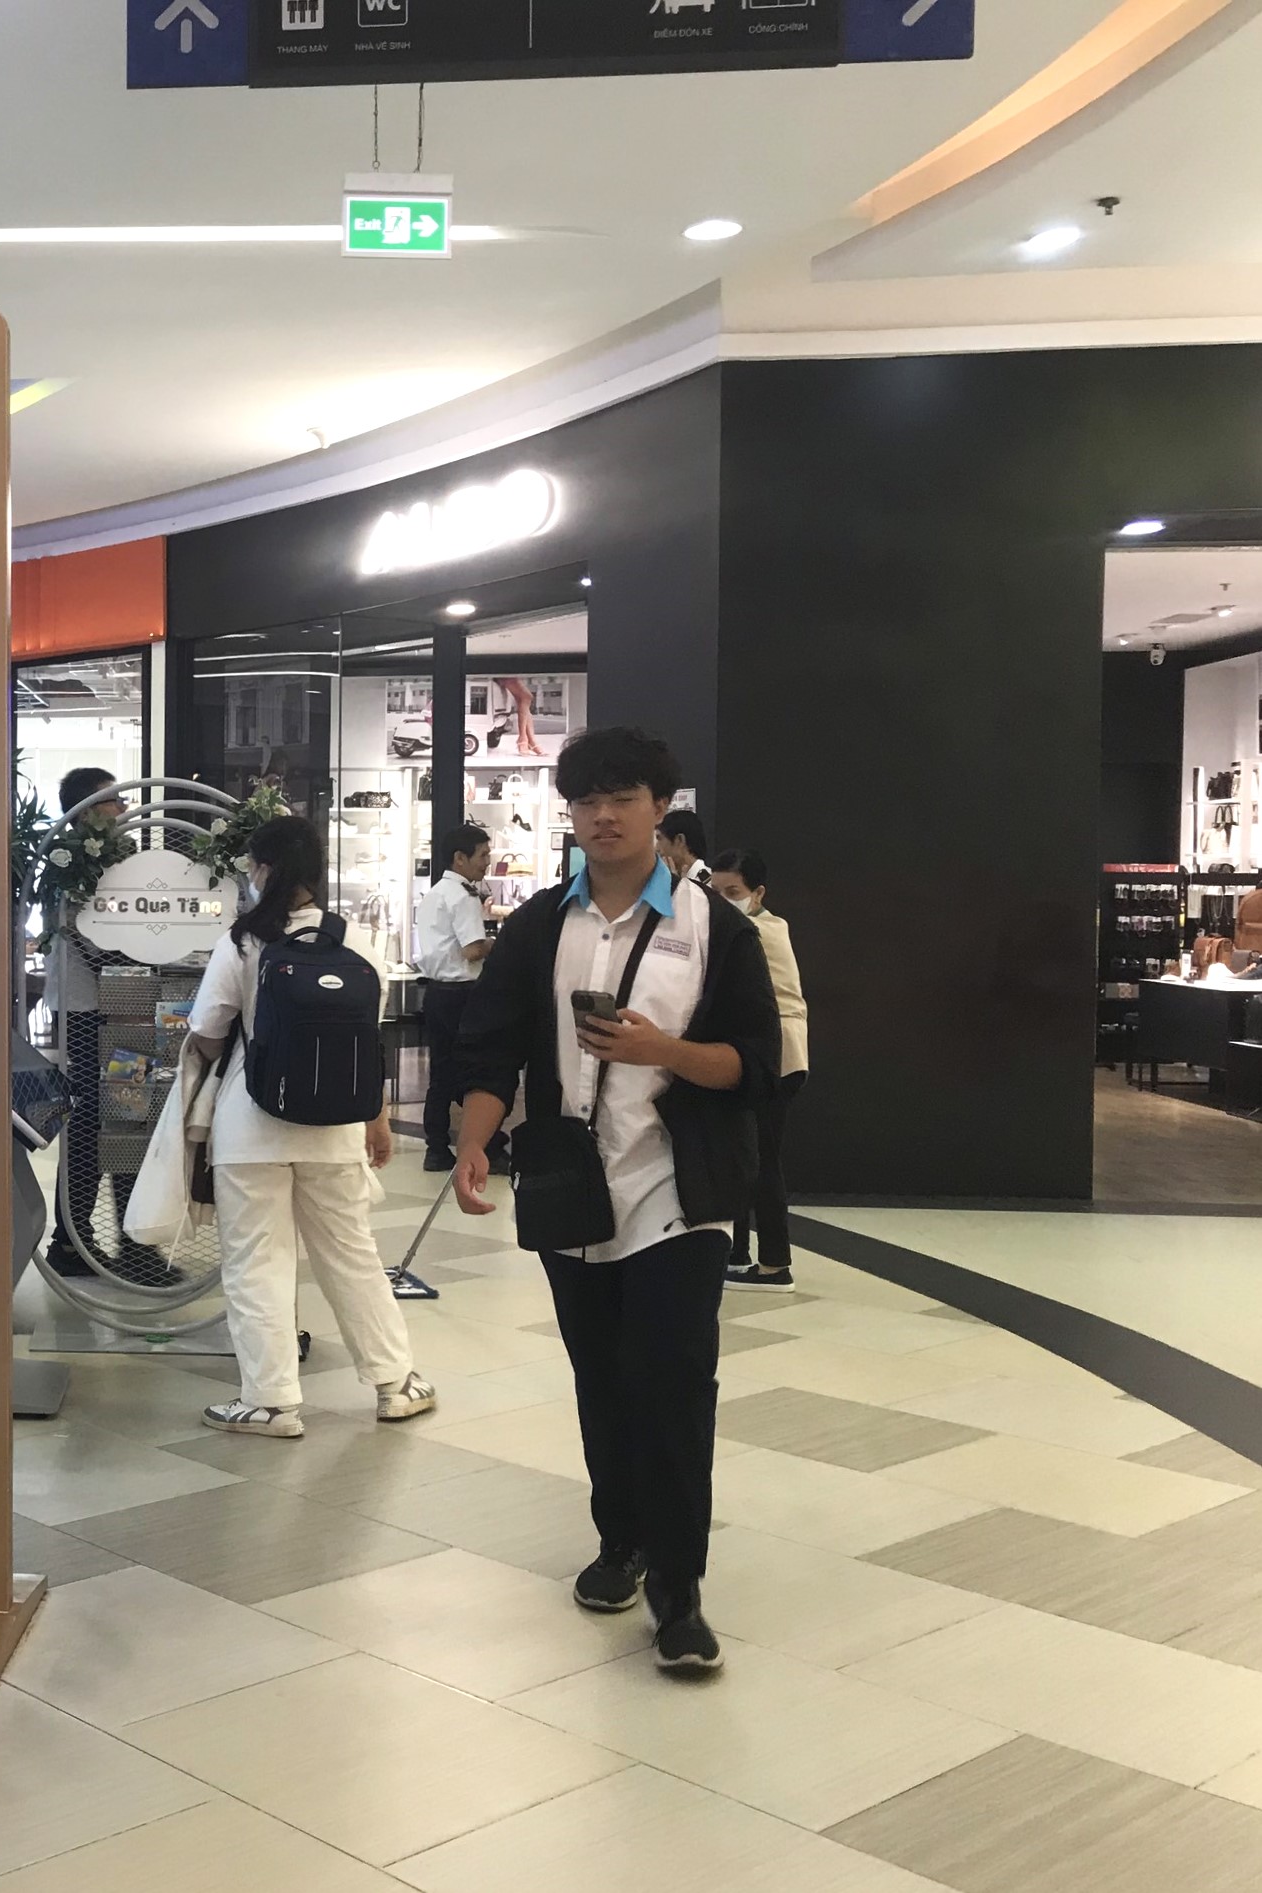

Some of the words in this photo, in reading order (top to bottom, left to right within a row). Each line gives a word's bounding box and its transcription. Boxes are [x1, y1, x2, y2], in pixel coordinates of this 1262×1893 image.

[364, 0, 401, 12] WC
[702, 27, 713, 36] XE
[277, 45, 308, 54] THANG
[389, 41, 411, 50] SINH
[94, 896, 128, 913] Góc
[135, 896, 171, 914] Quà
[177, 897, 222, 918] Tặng
